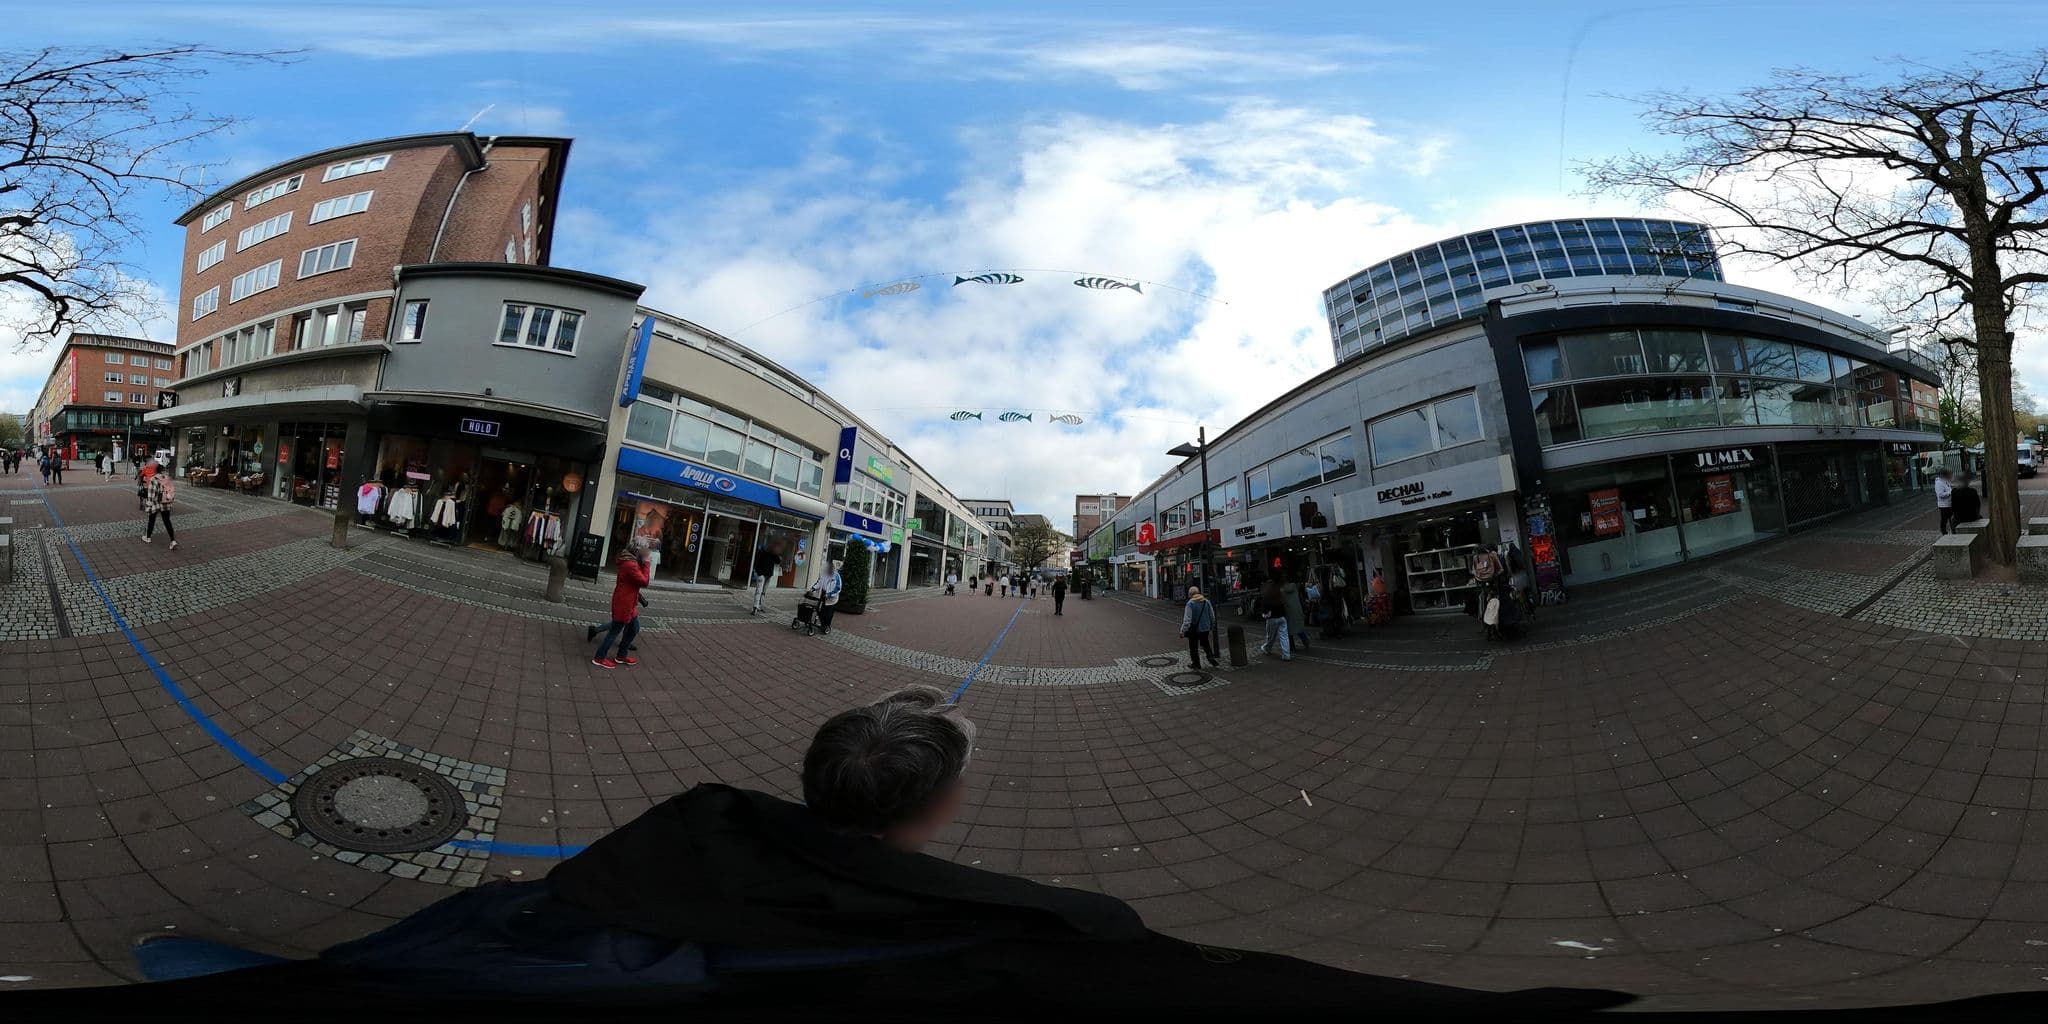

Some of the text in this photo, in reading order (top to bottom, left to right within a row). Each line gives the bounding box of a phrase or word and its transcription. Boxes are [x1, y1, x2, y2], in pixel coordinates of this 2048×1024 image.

[469, 421, 491, 434] HOLO
[1694, 448, 1754, 468] JUMEX
[680, 465, 715, 484] APOLLO
[1377, 480, 1424, 503] DECHAU
